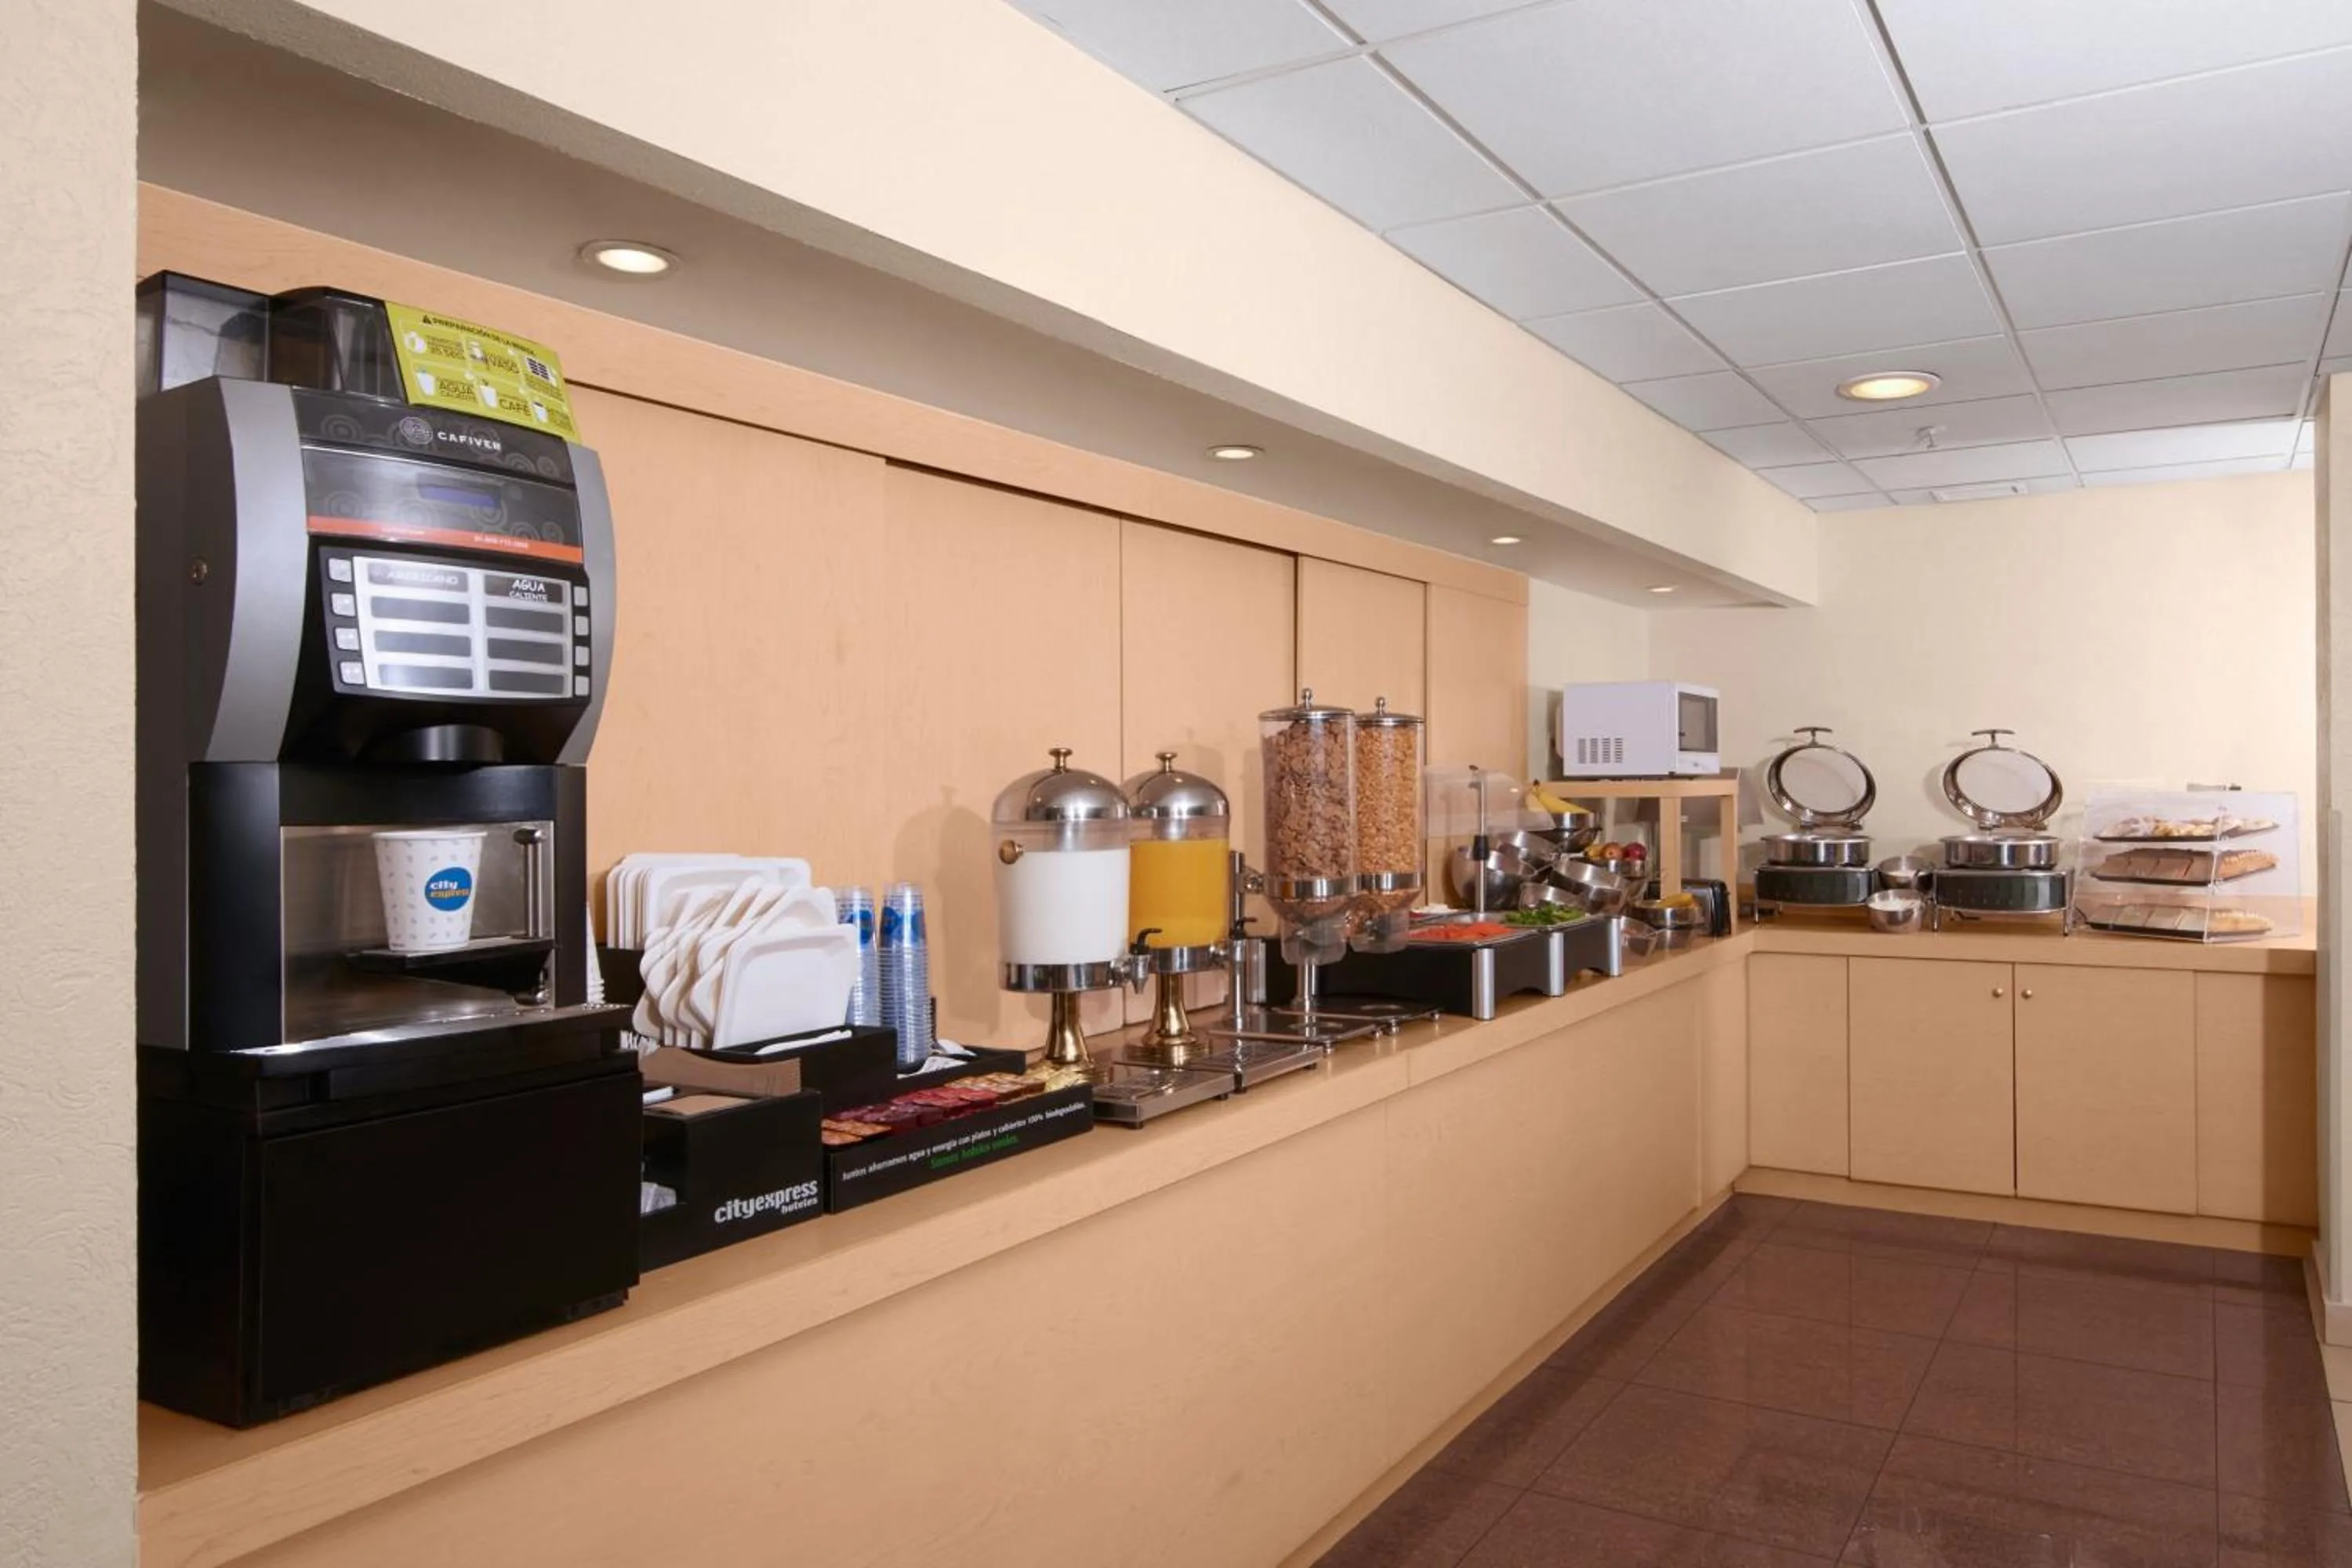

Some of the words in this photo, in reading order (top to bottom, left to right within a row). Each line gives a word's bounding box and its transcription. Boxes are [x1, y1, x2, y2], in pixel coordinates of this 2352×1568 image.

[386, 570, 459, 586] AMERICANO
[511, 579, 546, 593] AGUA
[508, 590, 548, 603] CALIENTE
[430, 880, 459, 890] city
[909, 1149, 926, 1161] agua
[958, 1136, 971, 1145] con
[971, 1129, 992, 1143] platos
[714, 1180, 818, 1223] cityexpress
[781, 1196, 818, 1214] hoteles
